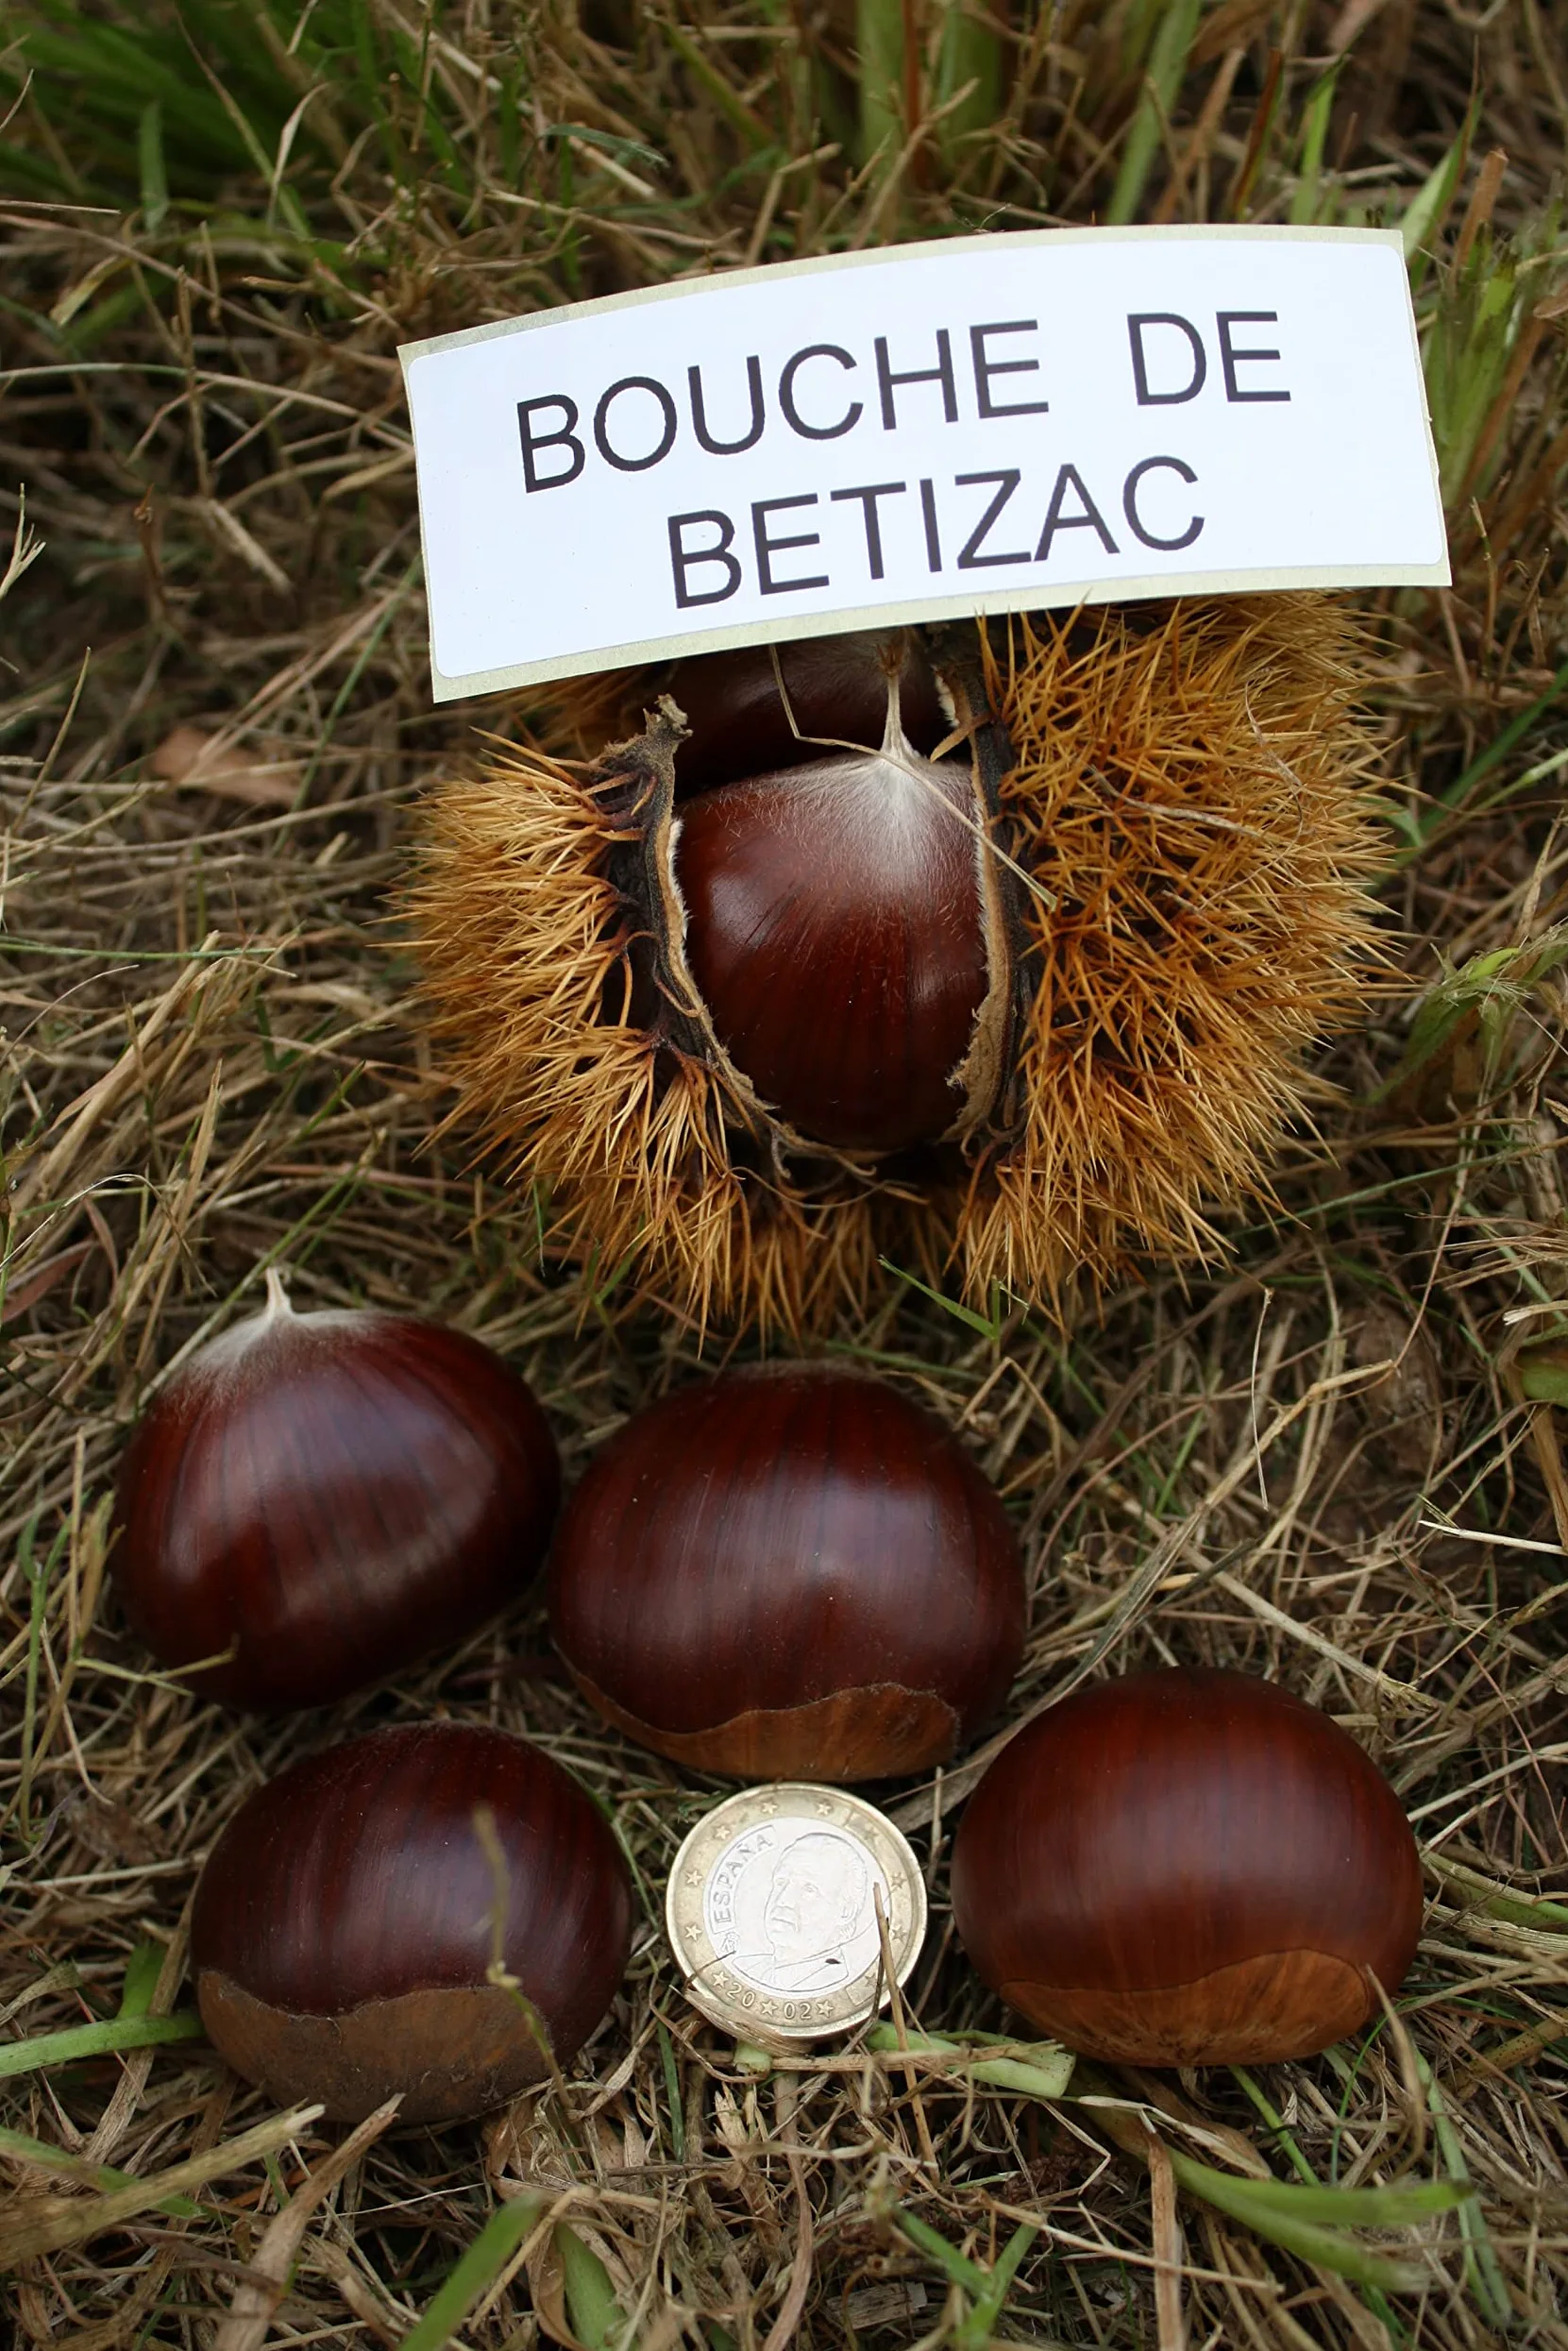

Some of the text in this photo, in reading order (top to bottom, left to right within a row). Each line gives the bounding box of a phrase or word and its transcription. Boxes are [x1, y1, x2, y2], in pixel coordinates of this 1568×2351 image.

[516, 312, 1290, 494] BOUCHE DE
[667, 457, 1205, 609] BETIZAC
[713, 1831, 773, 1925] ESPAÑA
